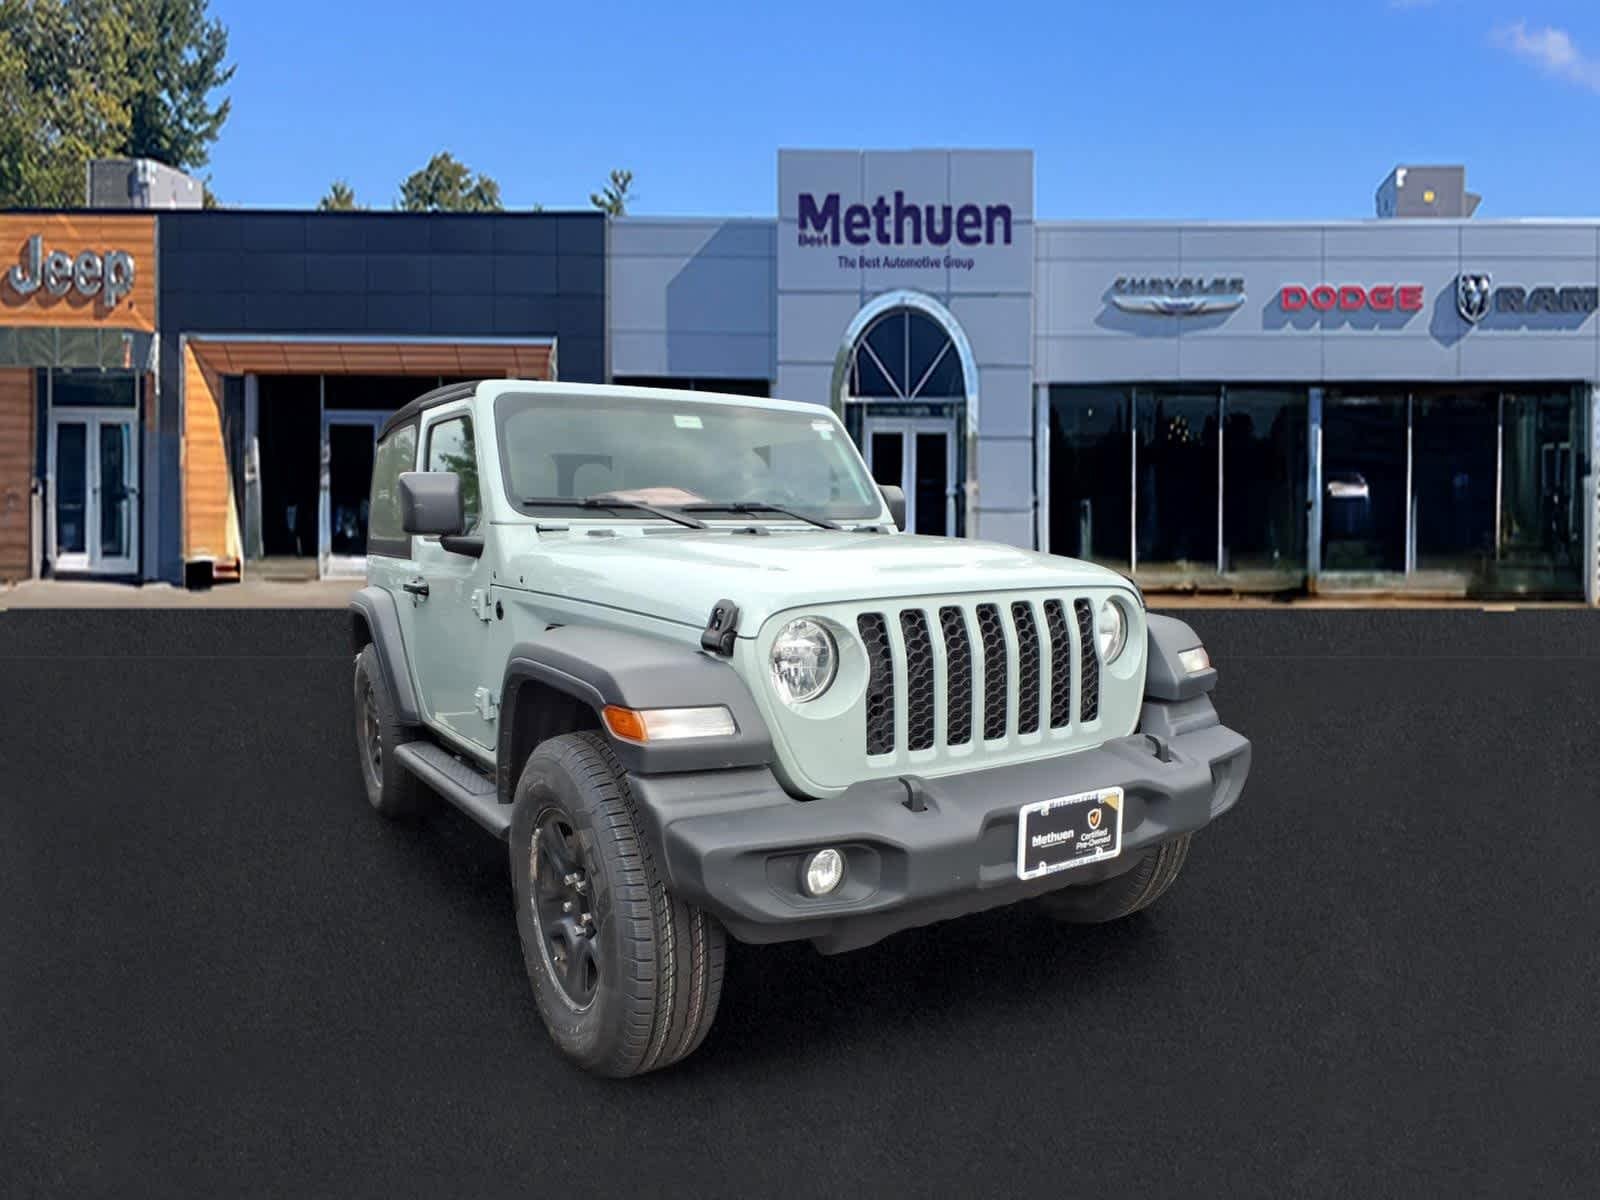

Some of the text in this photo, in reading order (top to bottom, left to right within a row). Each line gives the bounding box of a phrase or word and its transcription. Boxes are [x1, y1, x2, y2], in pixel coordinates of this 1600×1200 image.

[798, 190, 1012, 246] Methuen
[798, 233, 828, 247] Best
[8, 234, 136, 307] Jeep
[838, 255, 974, 271] The Best Automotive Group
[1113, 277, 1245, 295] CHRYSLER
[1280, 285, 1424, 311] DODGE
[1495, 286, 1599, 312] RAM
[1032, 829, 1074, 847] Methuen
[1081, 828, 1108, 842] Certified
